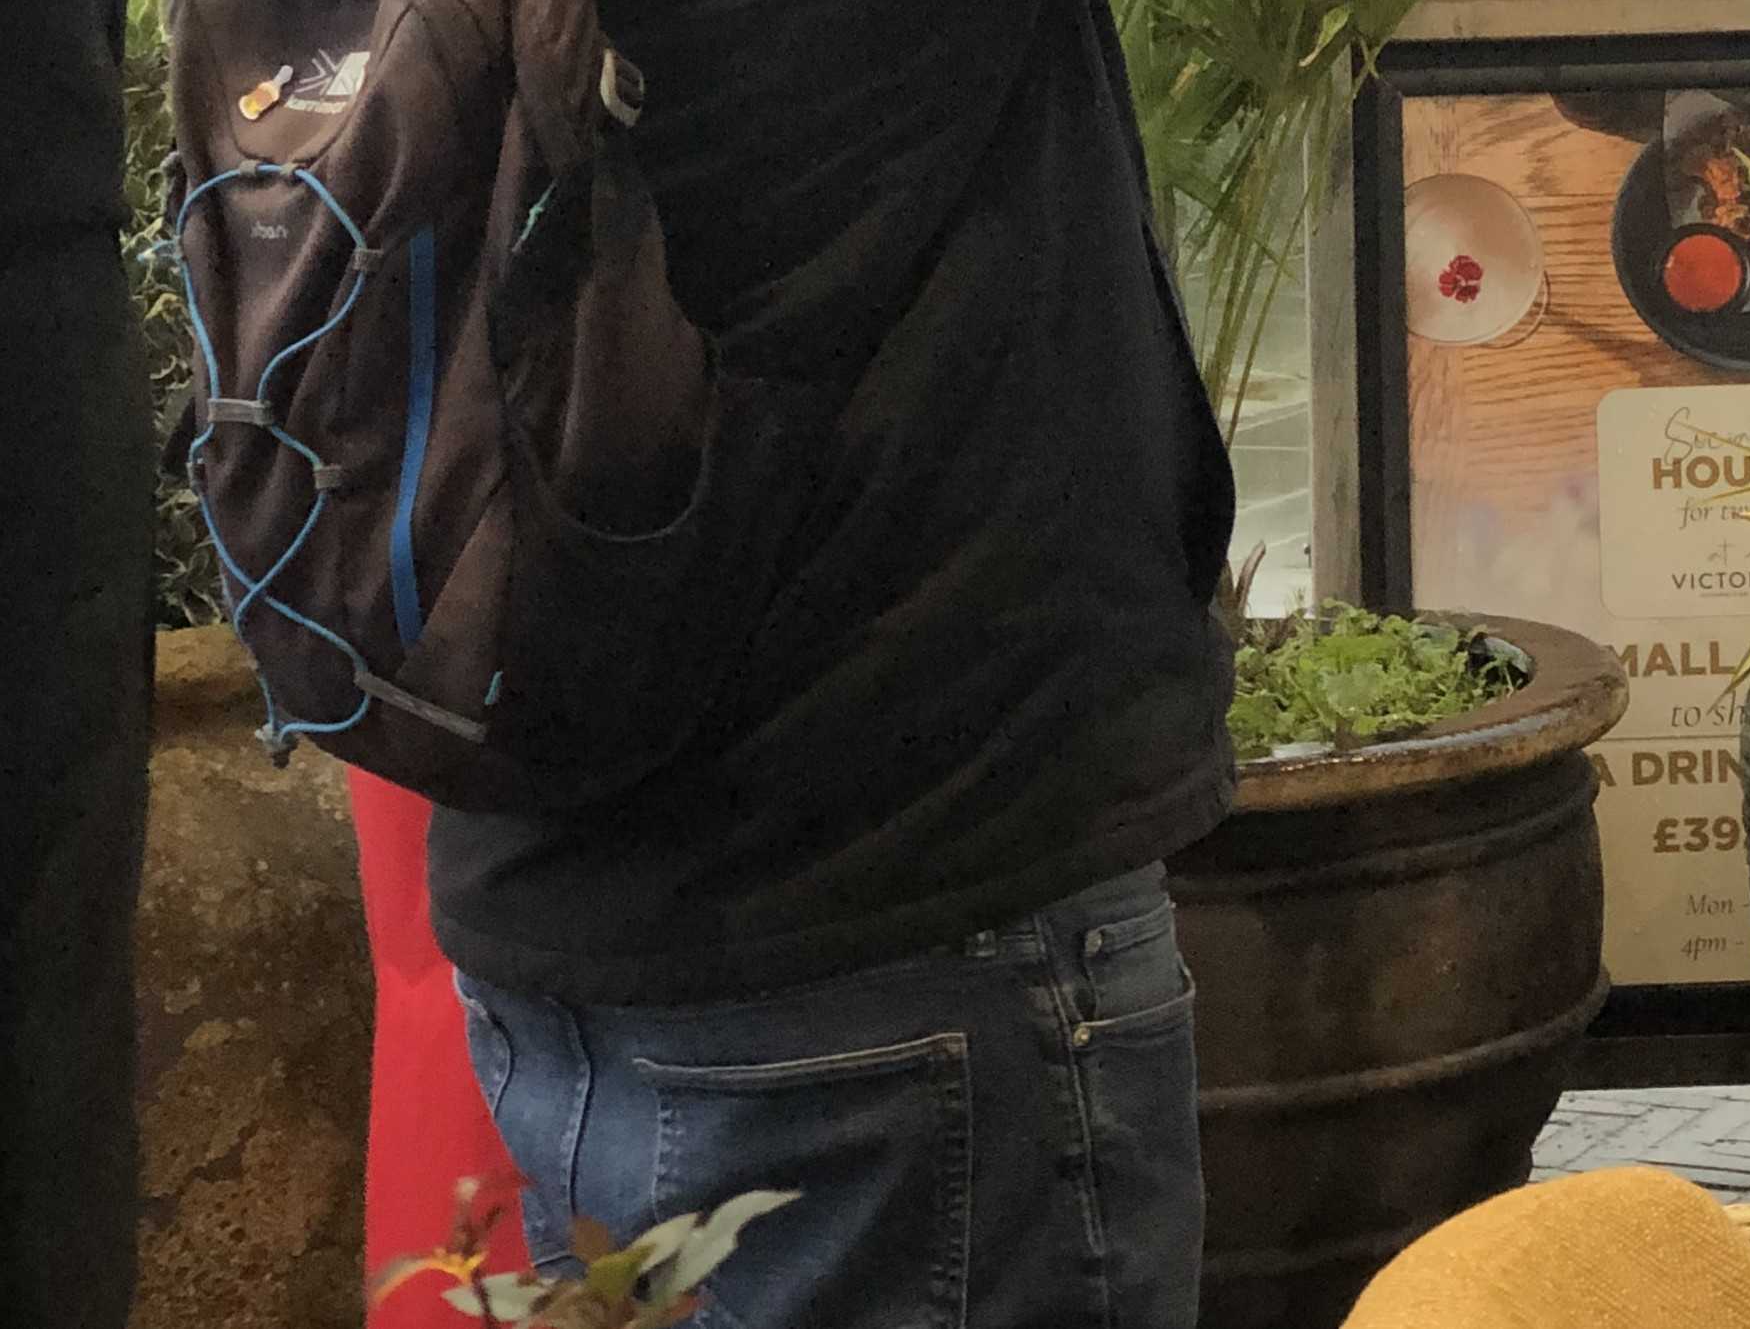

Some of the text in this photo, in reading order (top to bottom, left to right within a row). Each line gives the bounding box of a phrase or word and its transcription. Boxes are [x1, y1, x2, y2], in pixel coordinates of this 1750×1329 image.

[1677, 498, 1712, 529] for
[1671, 704, 1701, 728] to
[1631, 748, 1744, 787] DRIN
[1652, 815, 1741, 854] £39
[1684, 893, 1736, 916] Mon
[1680, 935, 1728, 961] 4pm
